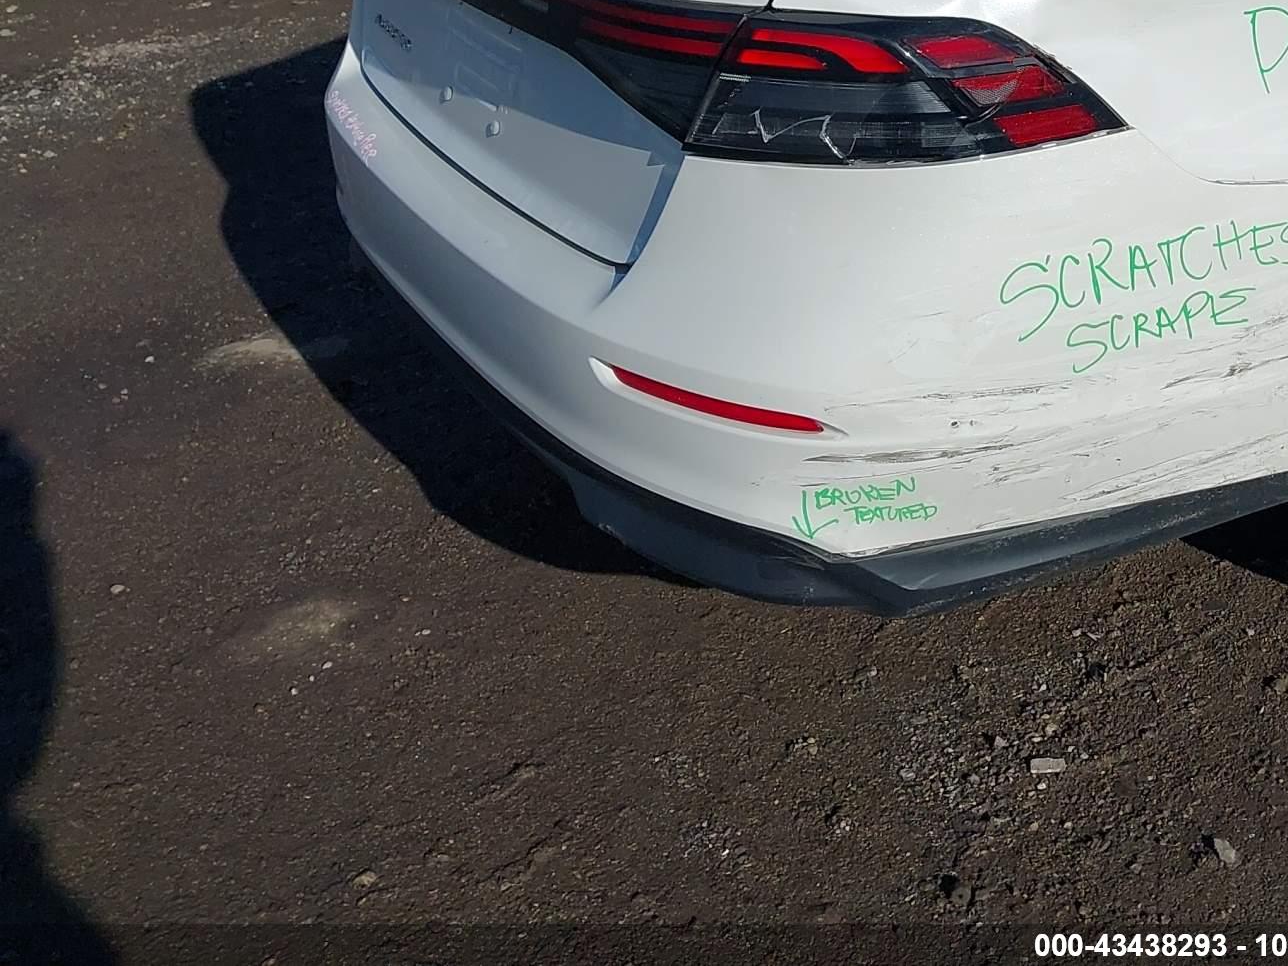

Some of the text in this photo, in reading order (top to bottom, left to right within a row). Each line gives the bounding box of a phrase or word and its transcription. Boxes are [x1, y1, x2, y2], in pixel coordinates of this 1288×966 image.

[1066, 287, 1257, 374] SCRAPE
[814, 476, 917, 510] BROKEN
[843, 502, 939, 525] TEXTURED
